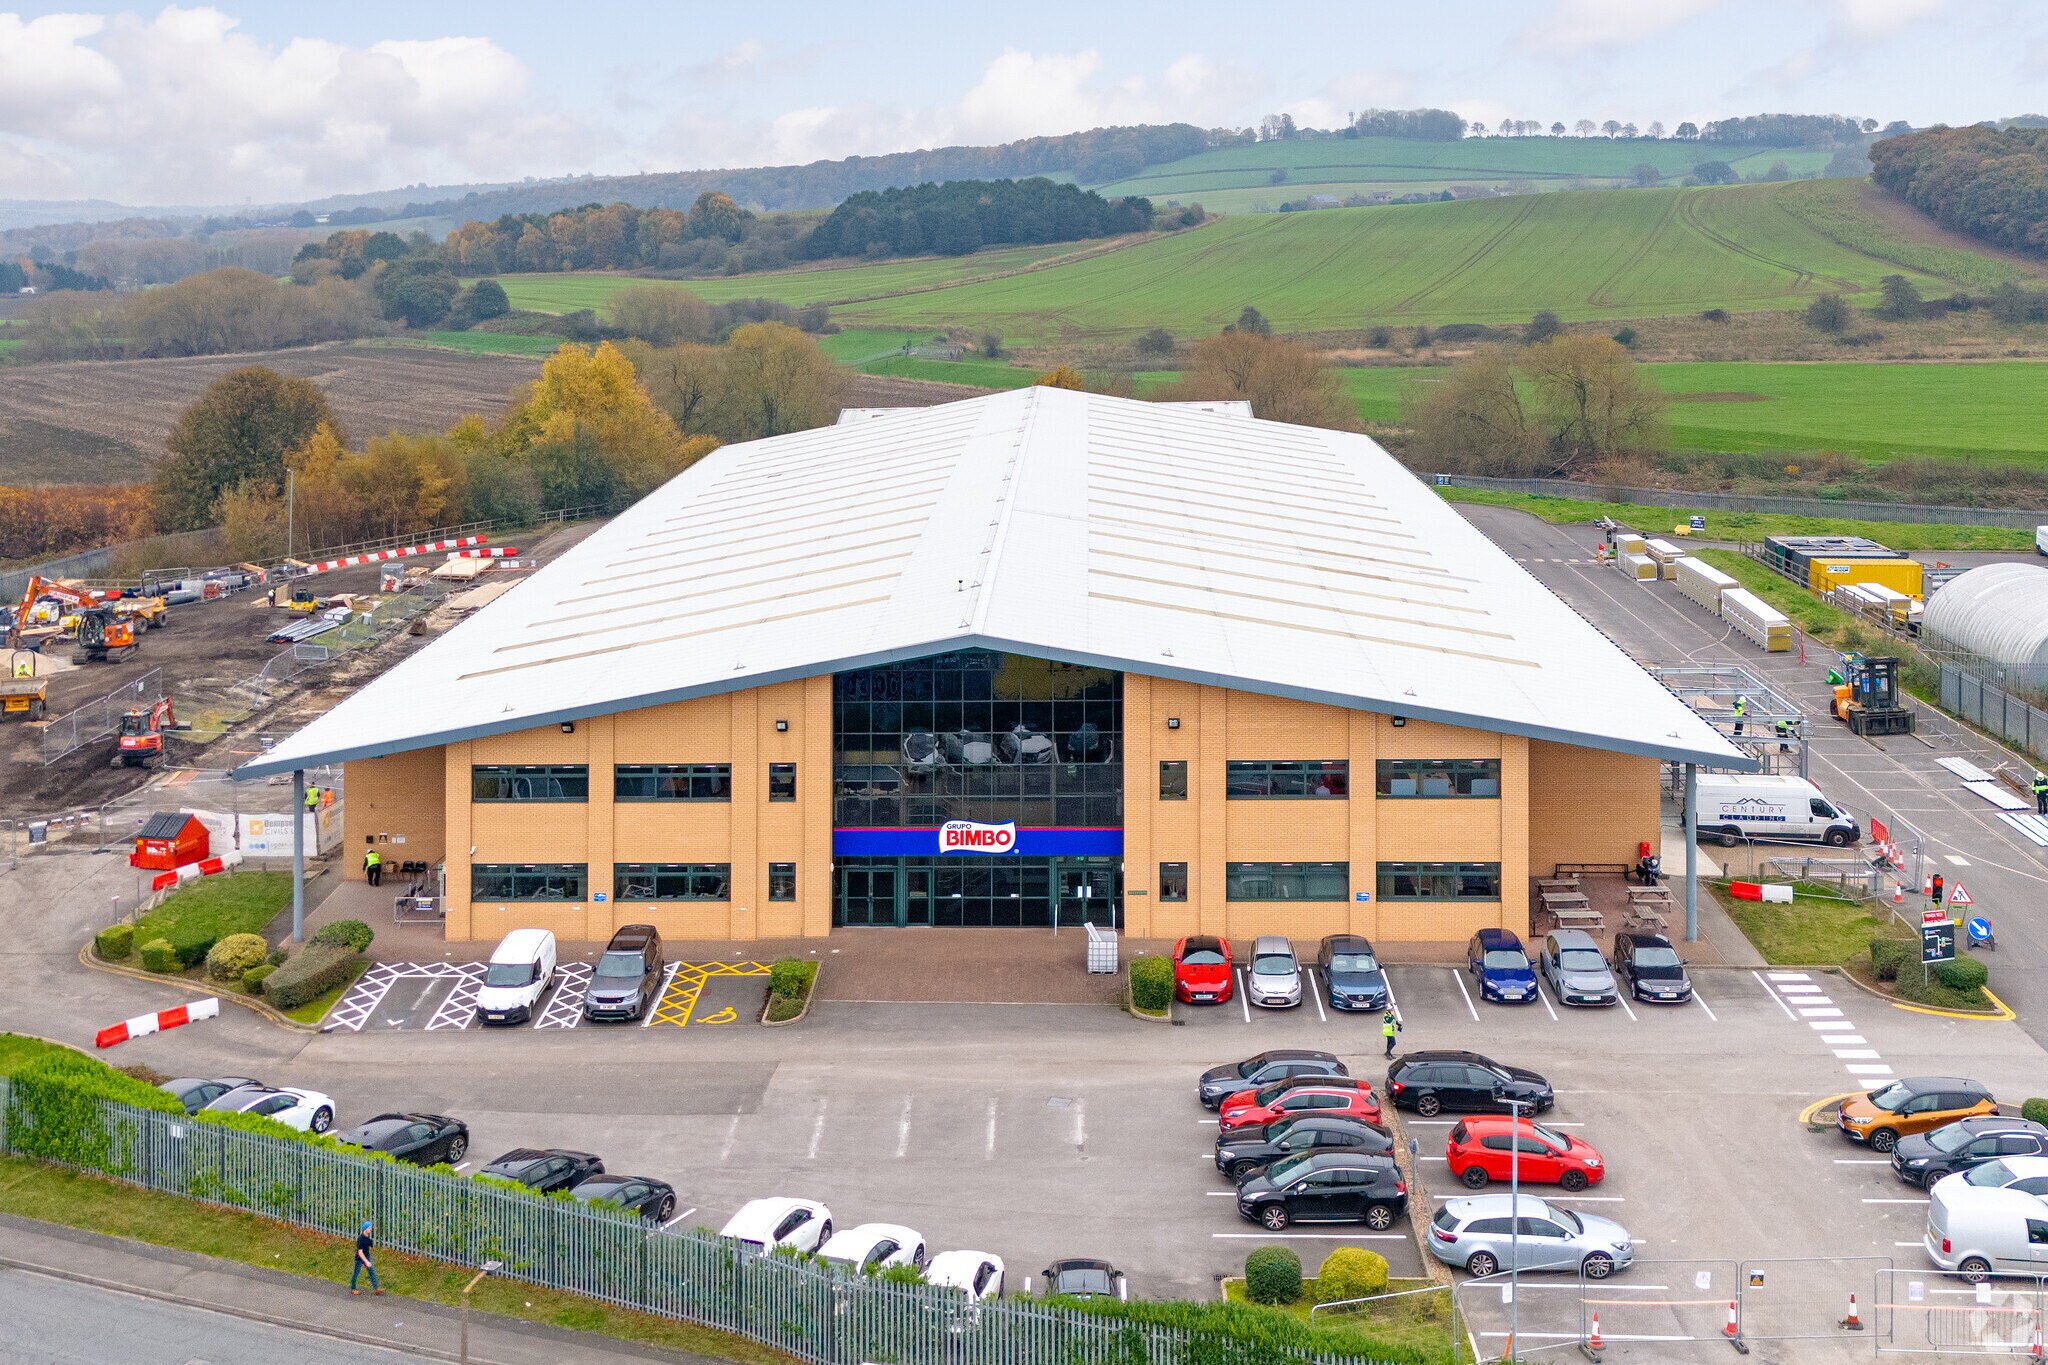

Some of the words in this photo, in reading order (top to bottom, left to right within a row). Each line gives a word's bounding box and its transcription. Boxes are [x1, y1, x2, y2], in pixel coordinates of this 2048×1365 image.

[1721, 805, 1784, 813] CENTURY
[264, 819, 294, 828] Dempse
[946, 830, 1011, 846] BIMBO
